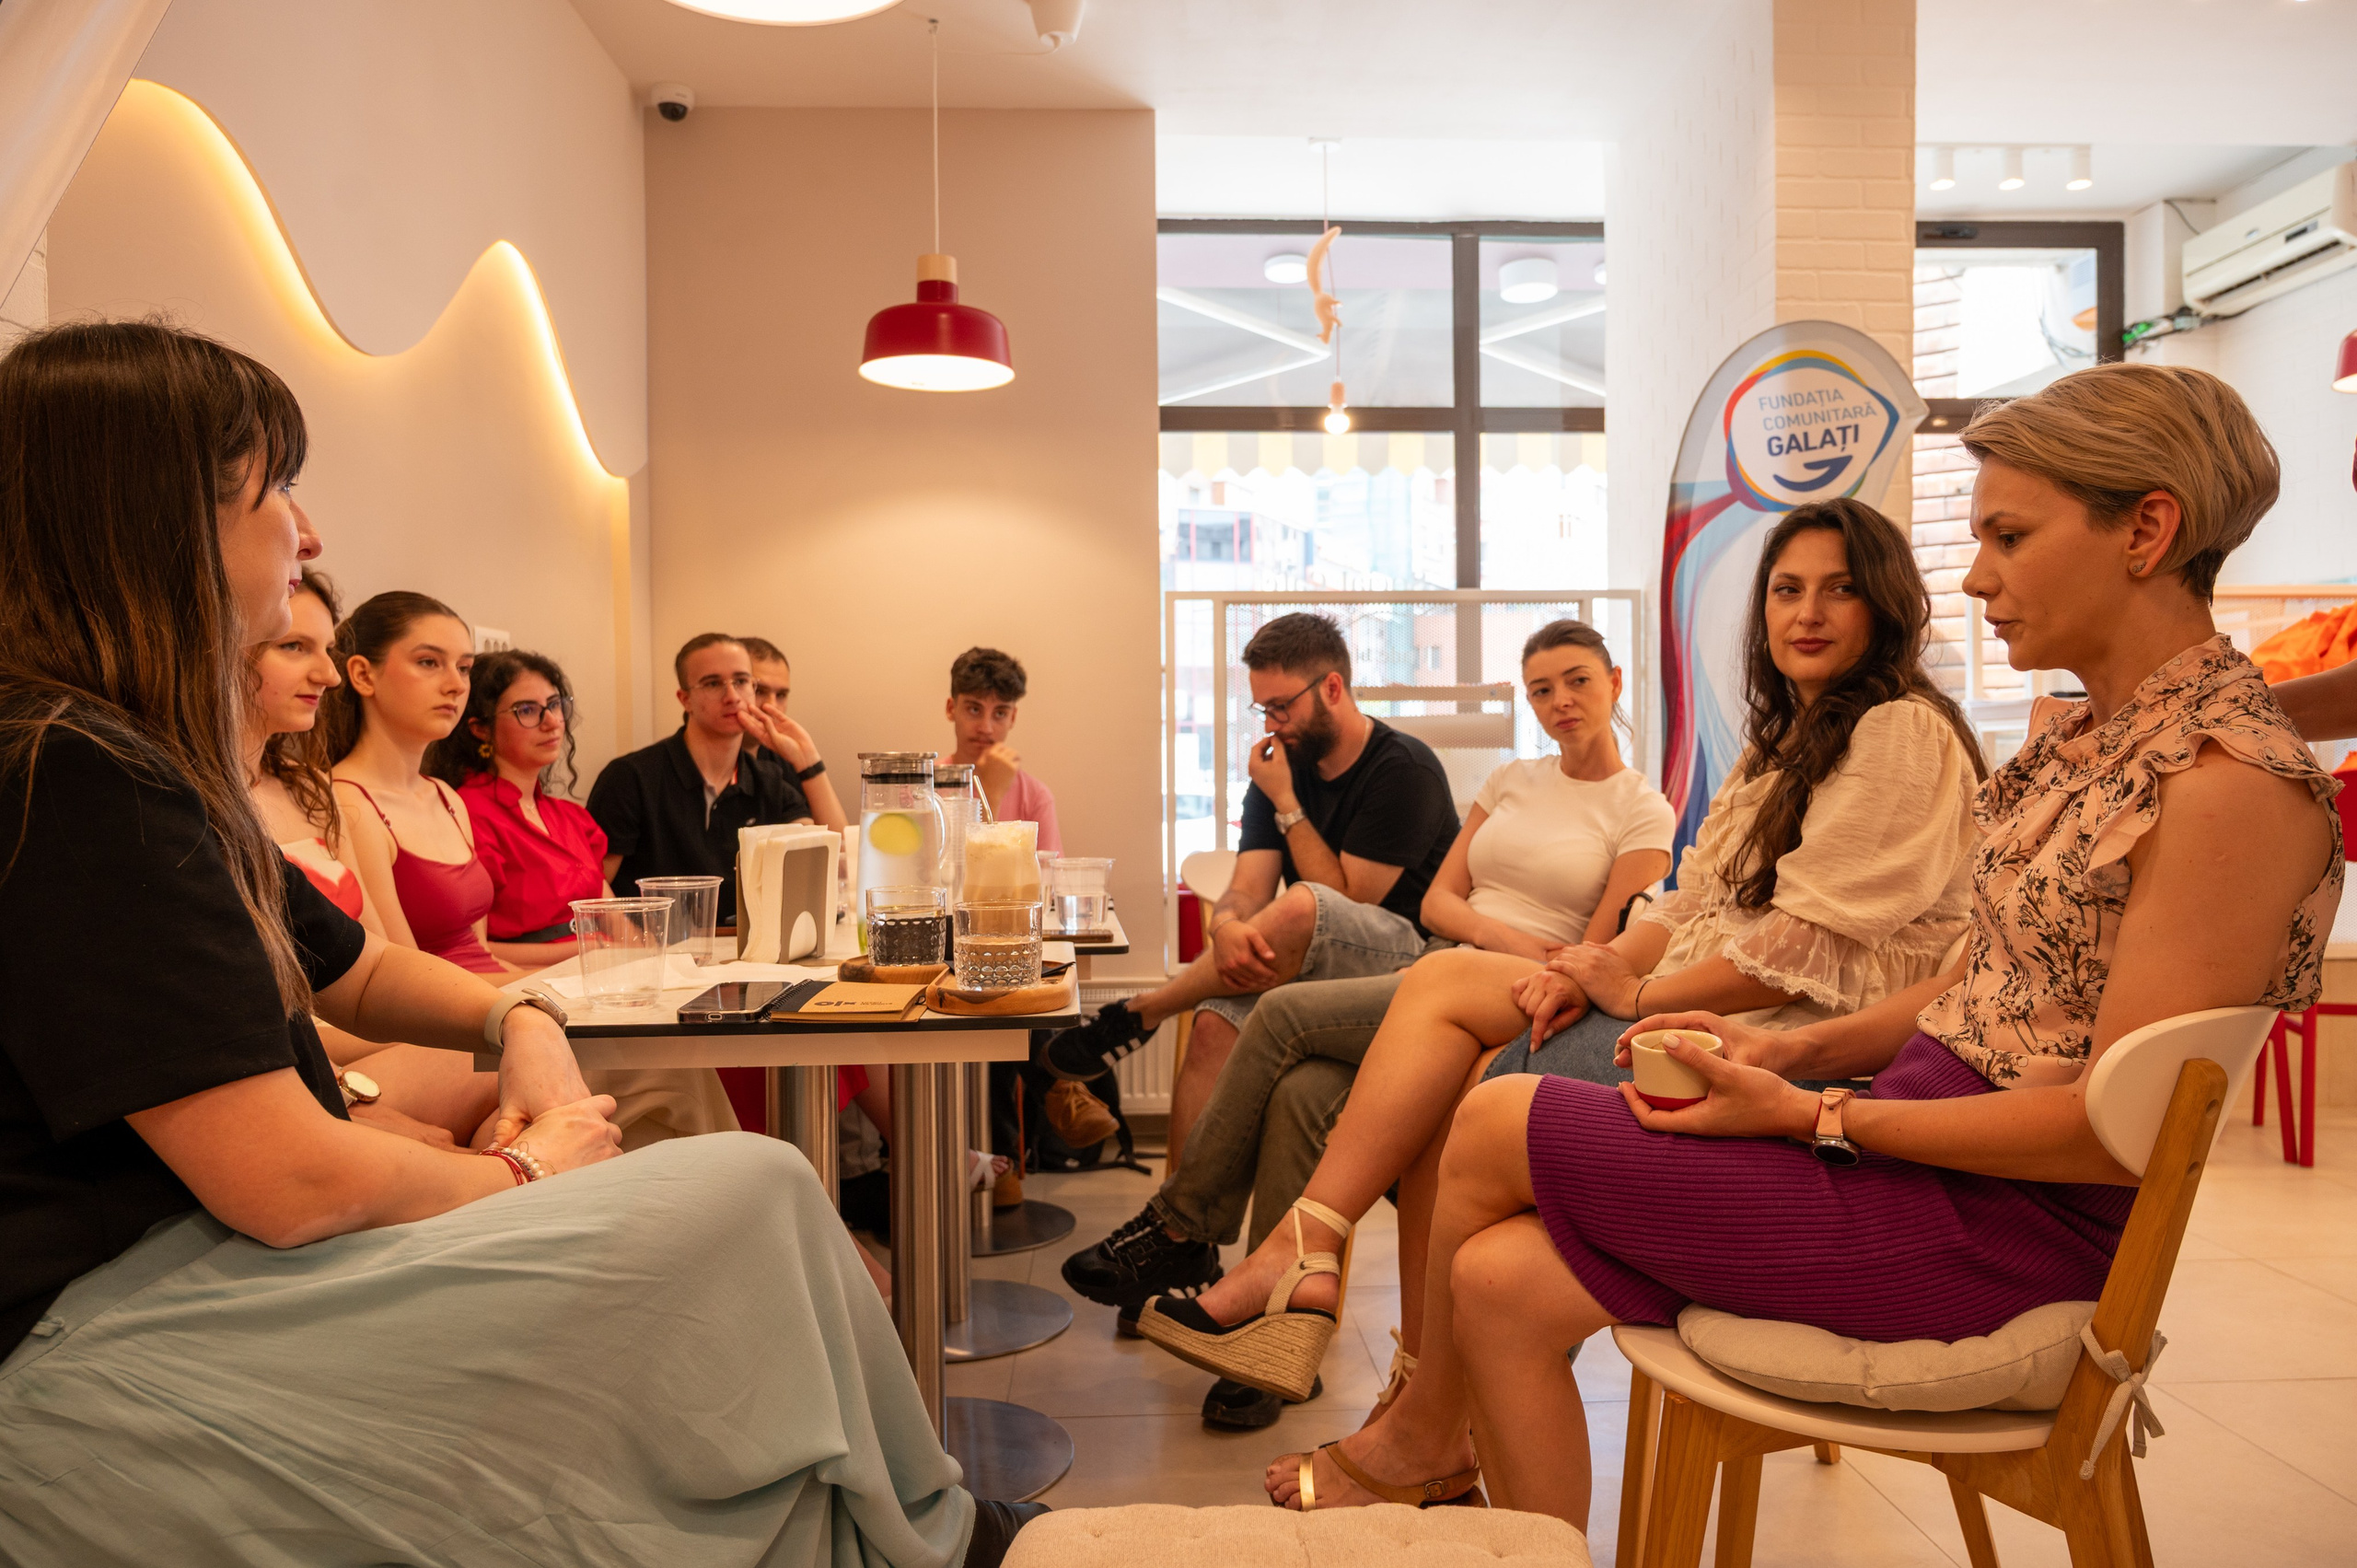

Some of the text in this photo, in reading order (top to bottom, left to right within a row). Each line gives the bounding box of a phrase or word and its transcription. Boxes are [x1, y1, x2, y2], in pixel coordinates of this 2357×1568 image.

[1759, 389, 1844, 412] FUNDAȚIA
[1762, 401, 1877, 432] COMUNITARĂ
[1767, 424, 1860, 457] GALAȚI
